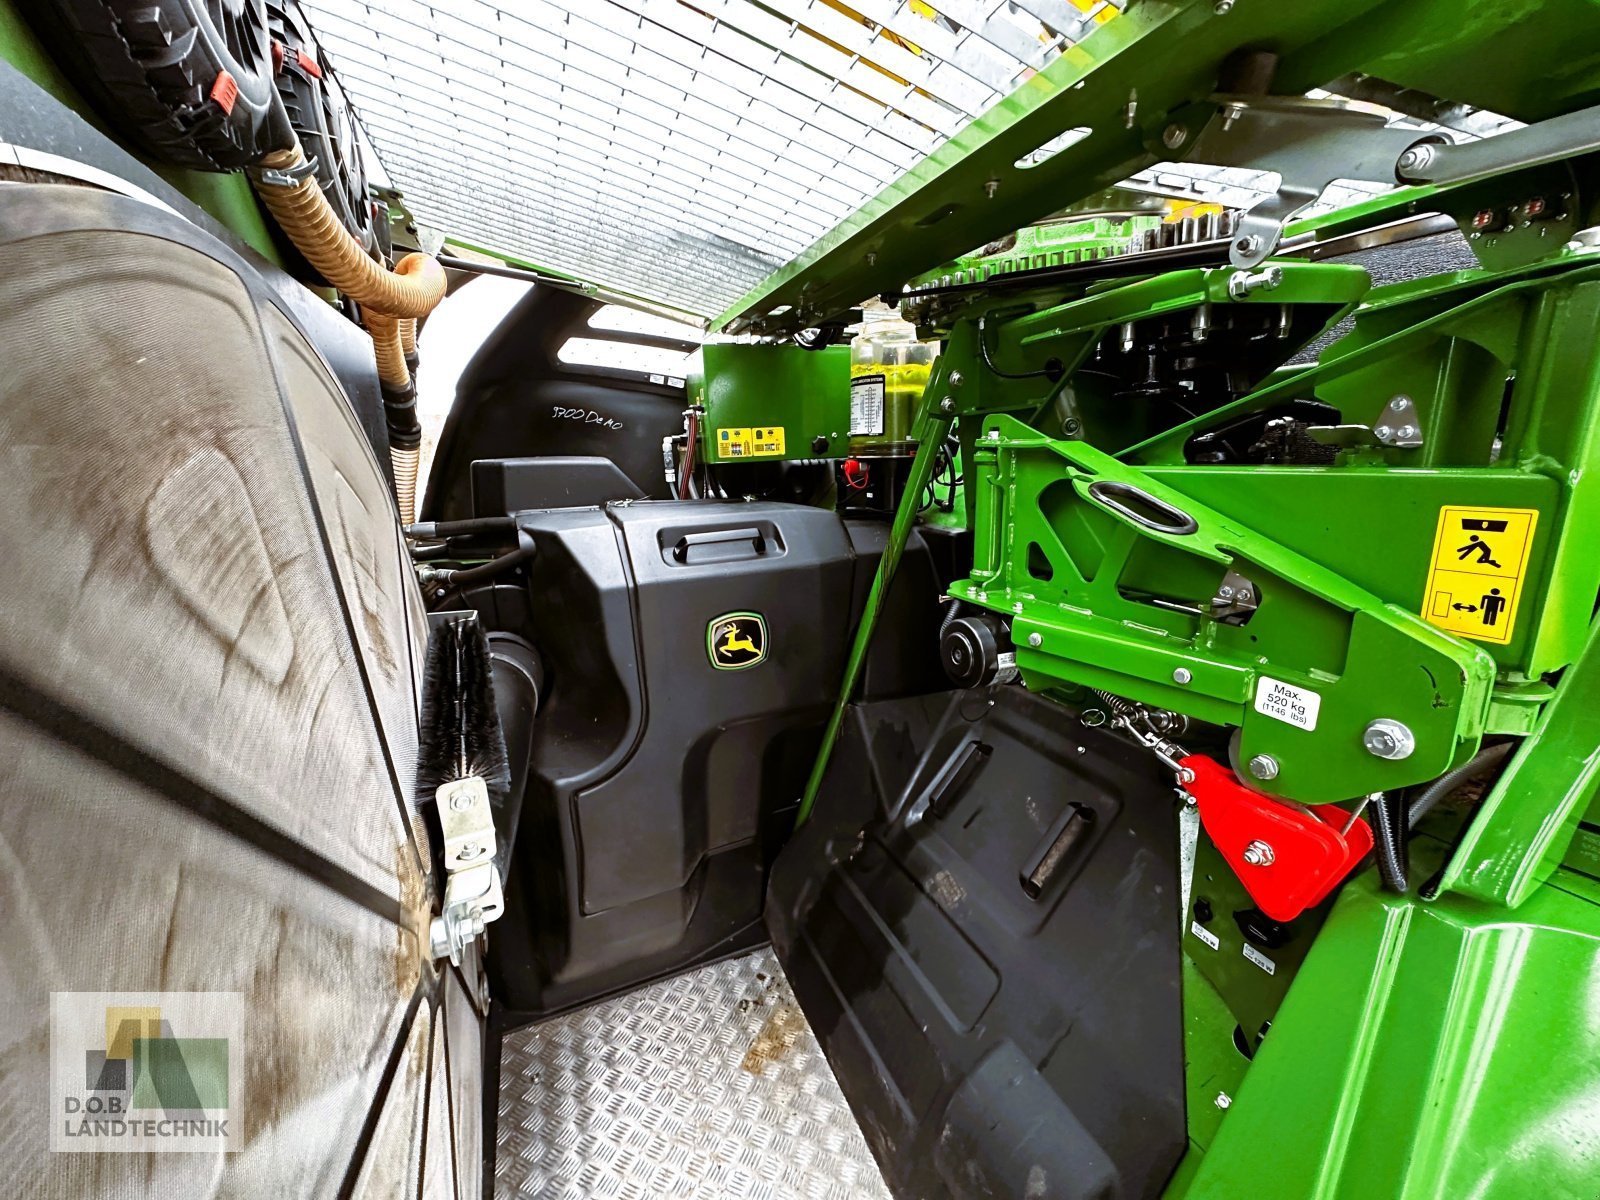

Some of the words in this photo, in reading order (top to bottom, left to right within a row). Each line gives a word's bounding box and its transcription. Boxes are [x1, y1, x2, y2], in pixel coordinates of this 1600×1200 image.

[552, 406, 585, 420] 9700
[1274, 684, 1302, 701] Max.
[1262, 702, 1286, 716] (1146
[1290, 712, 1307, 725] lbs)
[1267, 693, 1288, 707] 520
[1291, 701, 1305, 715] kg
